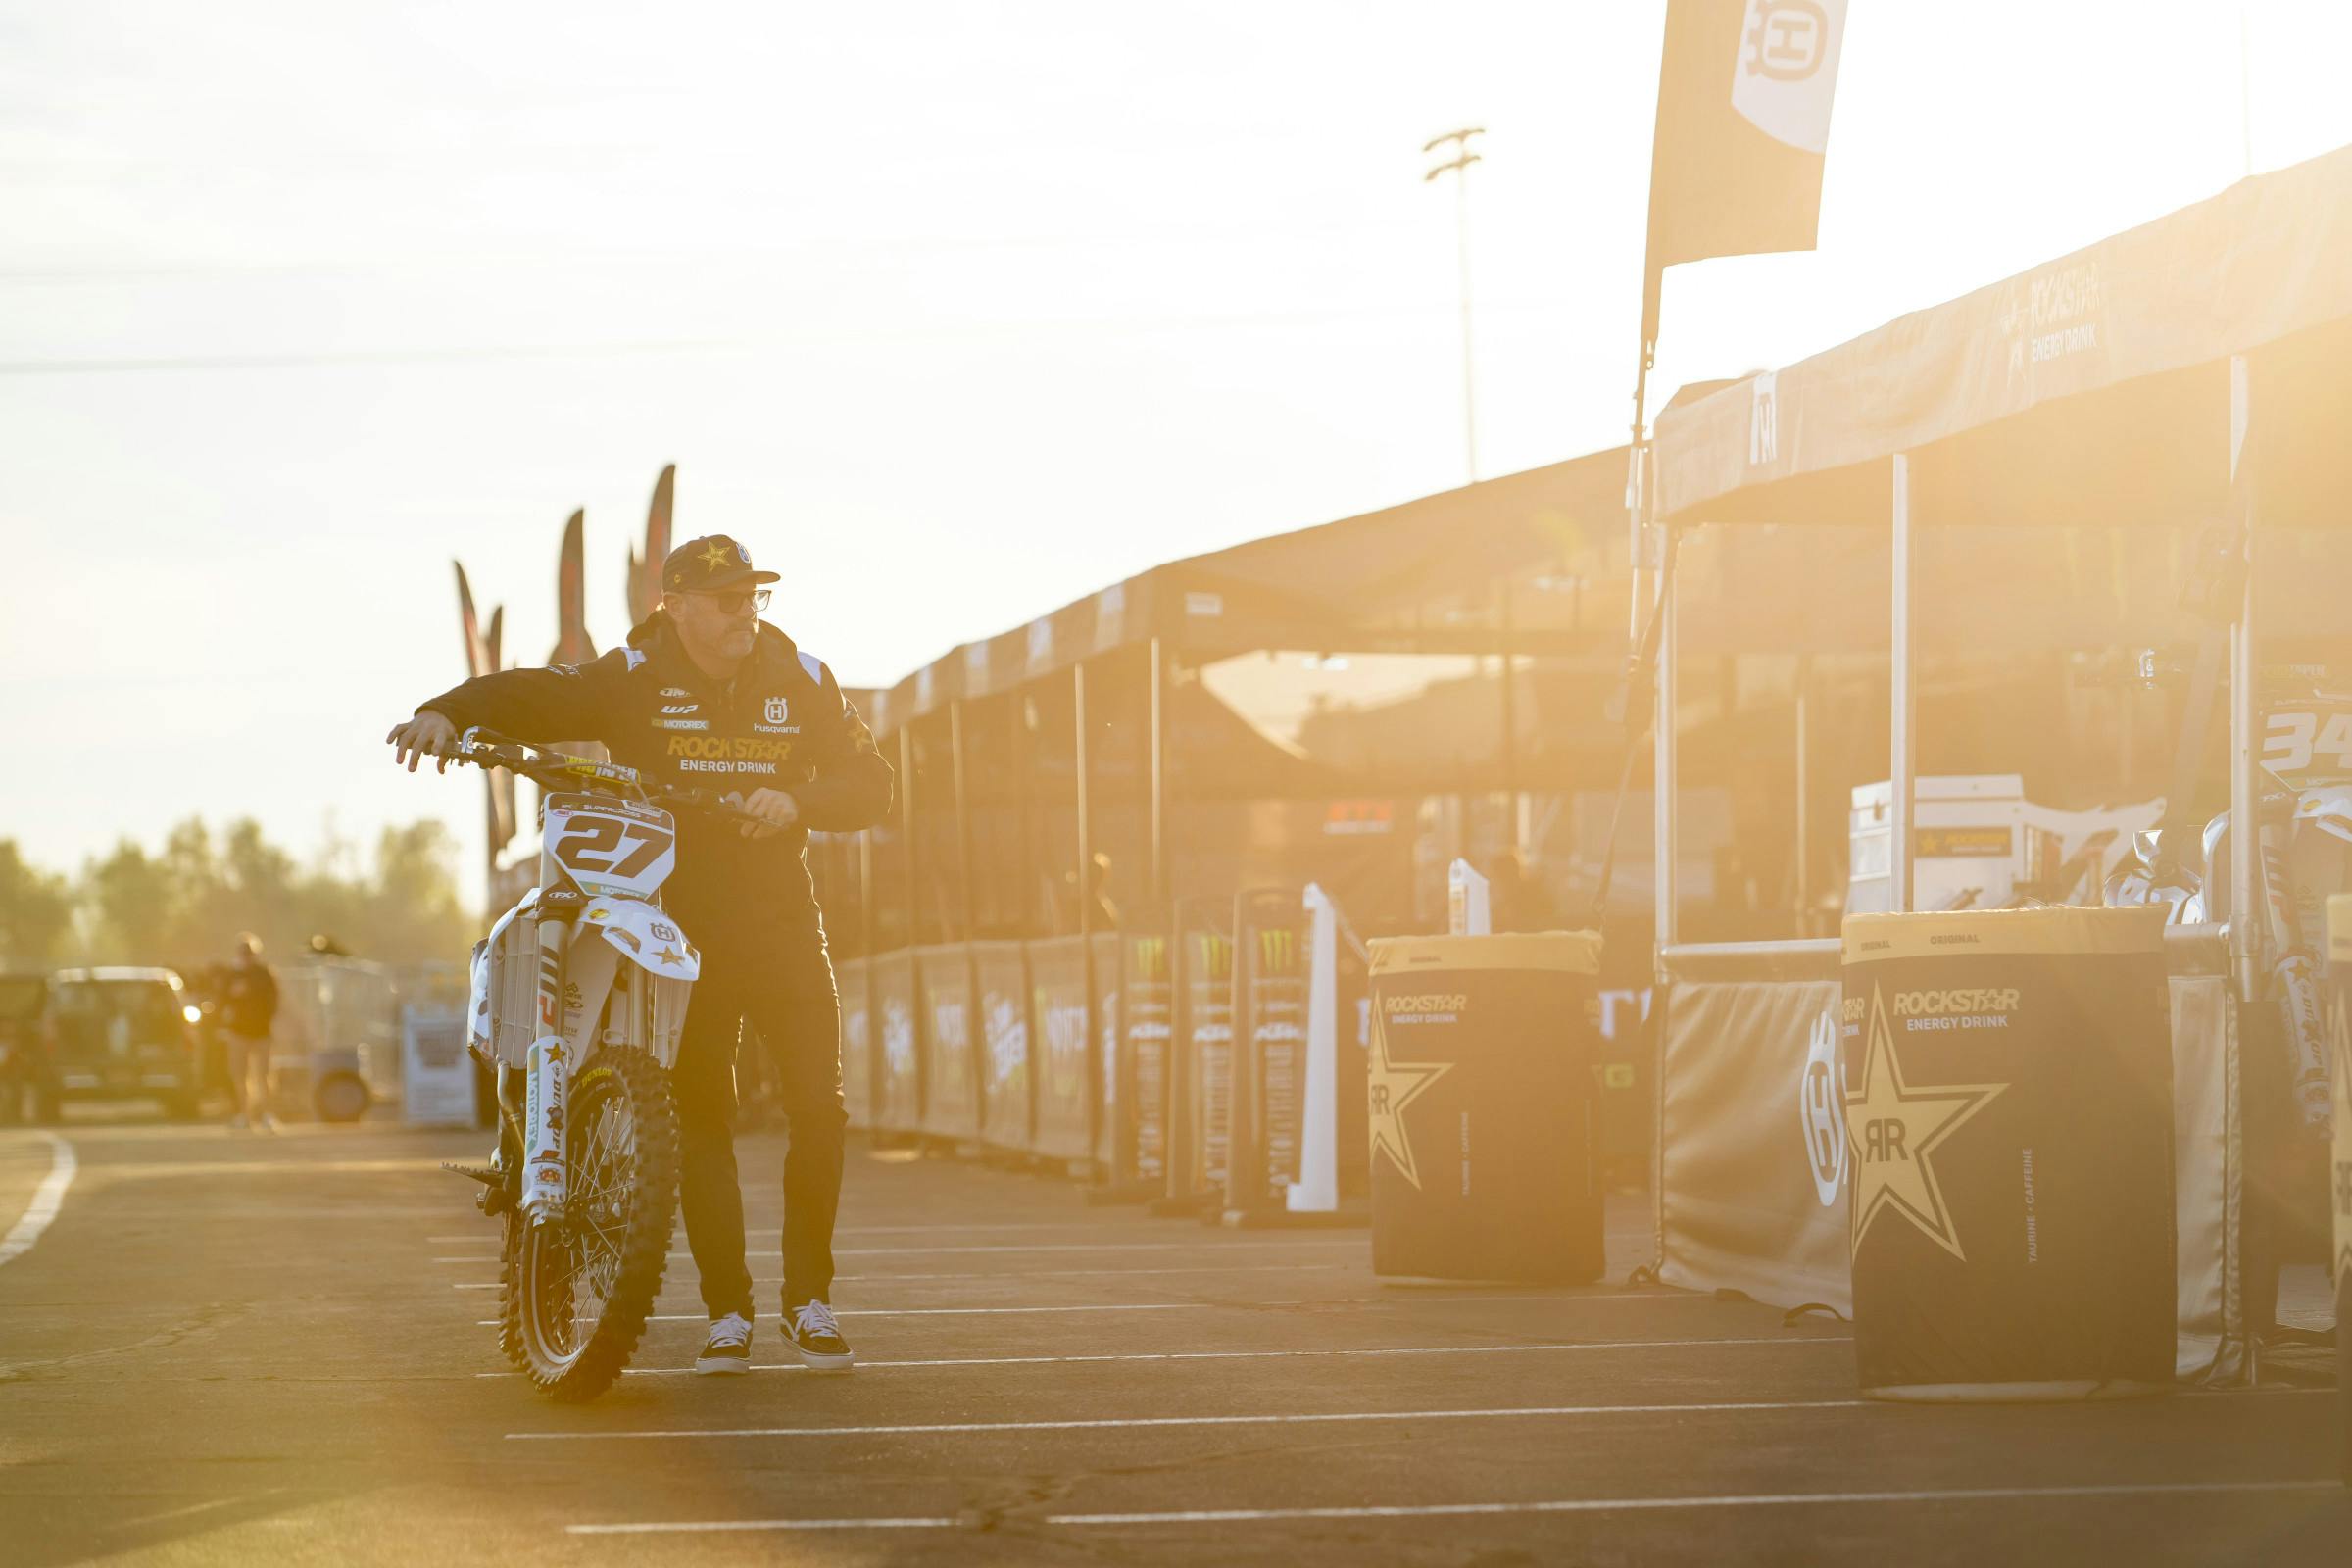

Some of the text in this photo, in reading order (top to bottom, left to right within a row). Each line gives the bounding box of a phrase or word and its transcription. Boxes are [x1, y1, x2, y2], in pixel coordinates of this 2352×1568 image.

[2032, 322, 2097, 362] ENERGY DRINK
[663, 720, 707, 730] MOTOREX
[754, 723, 800, 734] Husqvarna
[2259, 712, 2352, 772] 34
[680, 760, 776, 774] ENERGY DRINK
[555, 814, 673, 879] 27
[1930, 933, 1981, 945] ORIGINAL
[1385, 994, 1467, 1013] ROCKSTAR
[1893, 988, 2021, 1016] ROCKSTAR
[1906, 1015, 2009, 1031] ENERGY DRINK
[2023, 1148, 2037, 1263] TAURINE CAFFEINE
